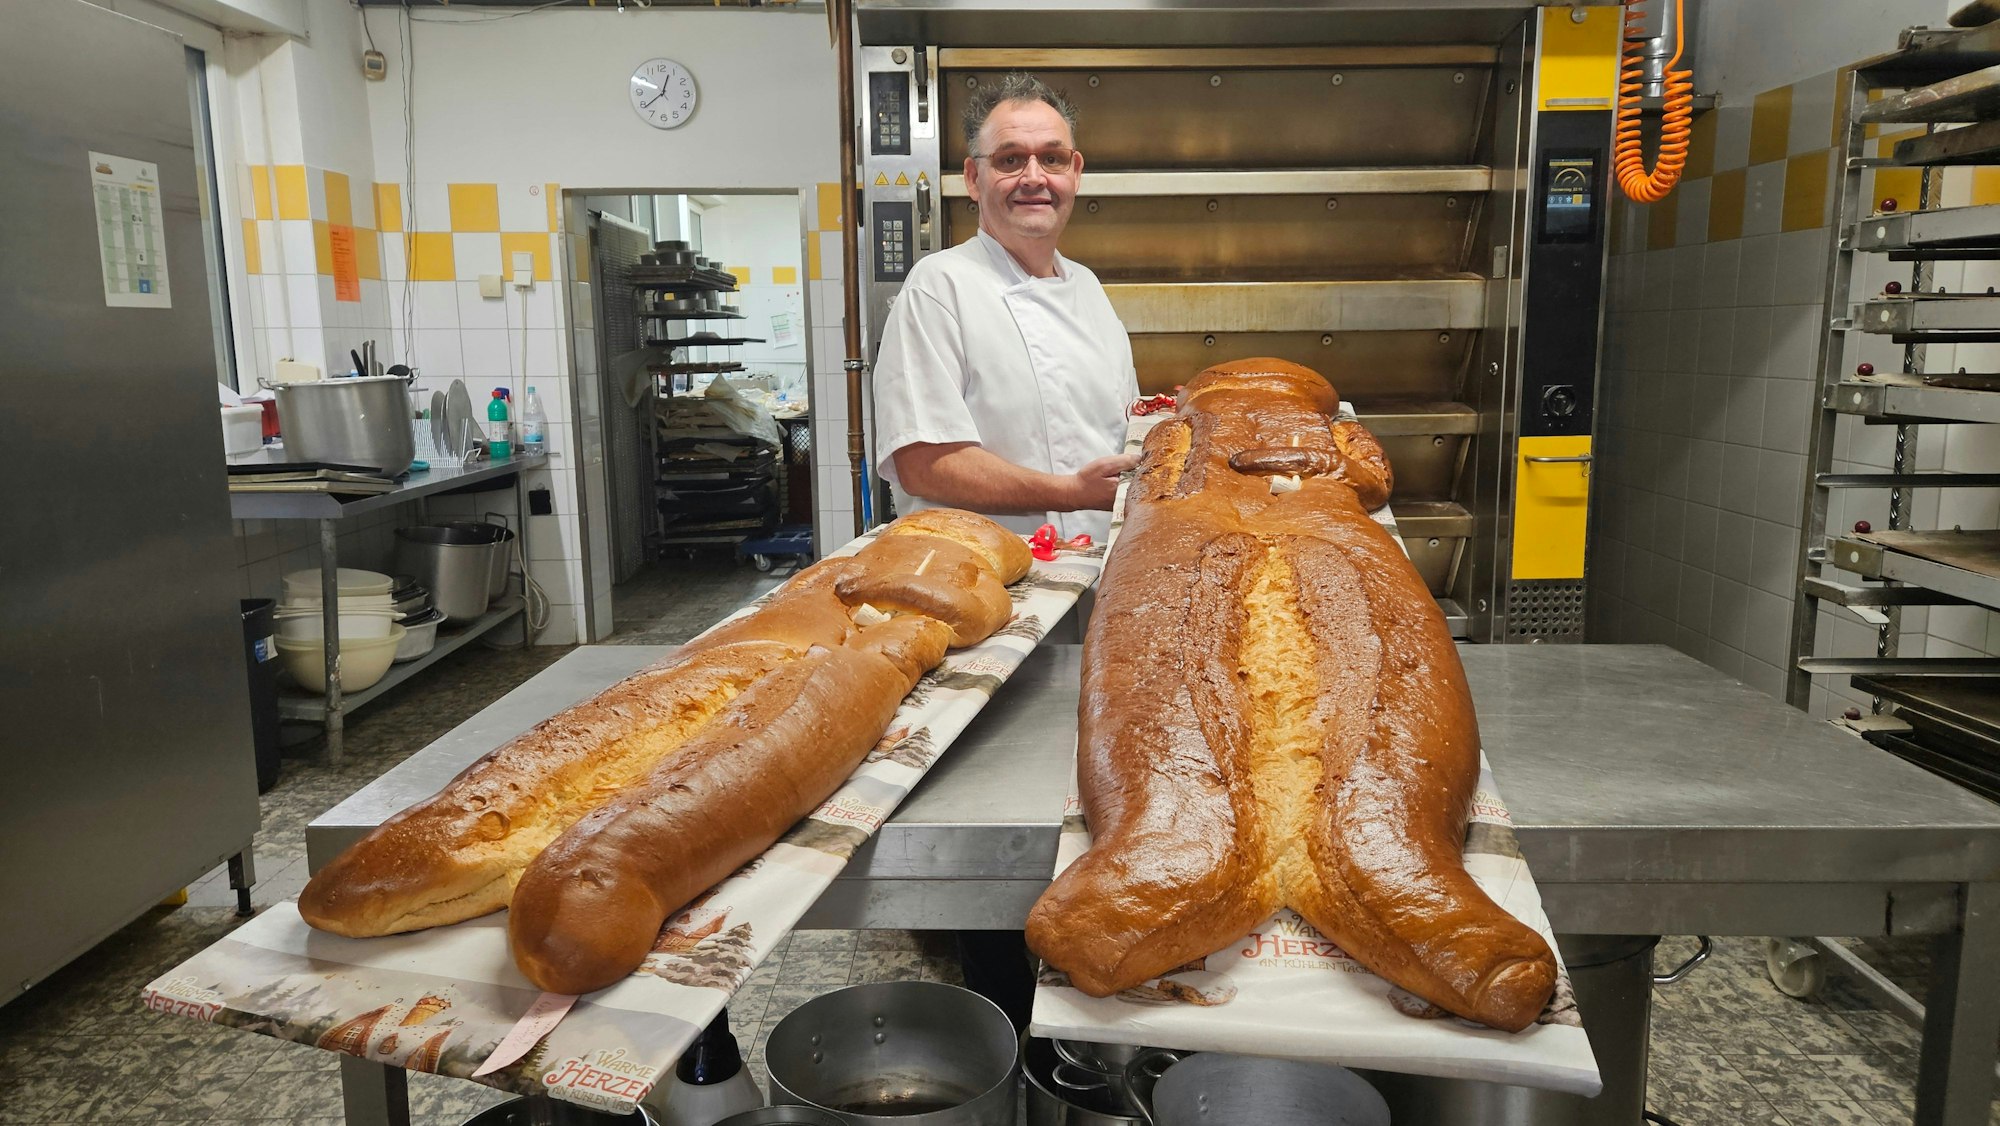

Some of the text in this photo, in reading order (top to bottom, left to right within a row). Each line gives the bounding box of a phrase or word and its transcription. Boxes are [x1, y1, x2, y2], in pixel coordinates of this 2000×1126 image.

[657, 64, 667, 72] 12
[680, 77, 686, 85] 2
[635, 88, 644, 96] 9
[683, 90, 690, 98] 3
[640, 101, 646, 109] 8
[680, 102, 687, 110] 4
[648, 110, 656, 120] 7
[660, 113, 668, 122] 6
[672, 111, 679, 119] 5
[840, 797, 884, 816] WARME
[1259, 958, 1278, 968] AN
[1284, 959, 1336, 971] KÜHLEN
[163, 977, 215, 1001] WARME
[596, 1049, 656, 1079] WARME
[545, 1060, 655, 1103] HERZEN
[552, 1086, 567, 1096] AN
[569, 1088, 611, 1107] KÜHLEN
